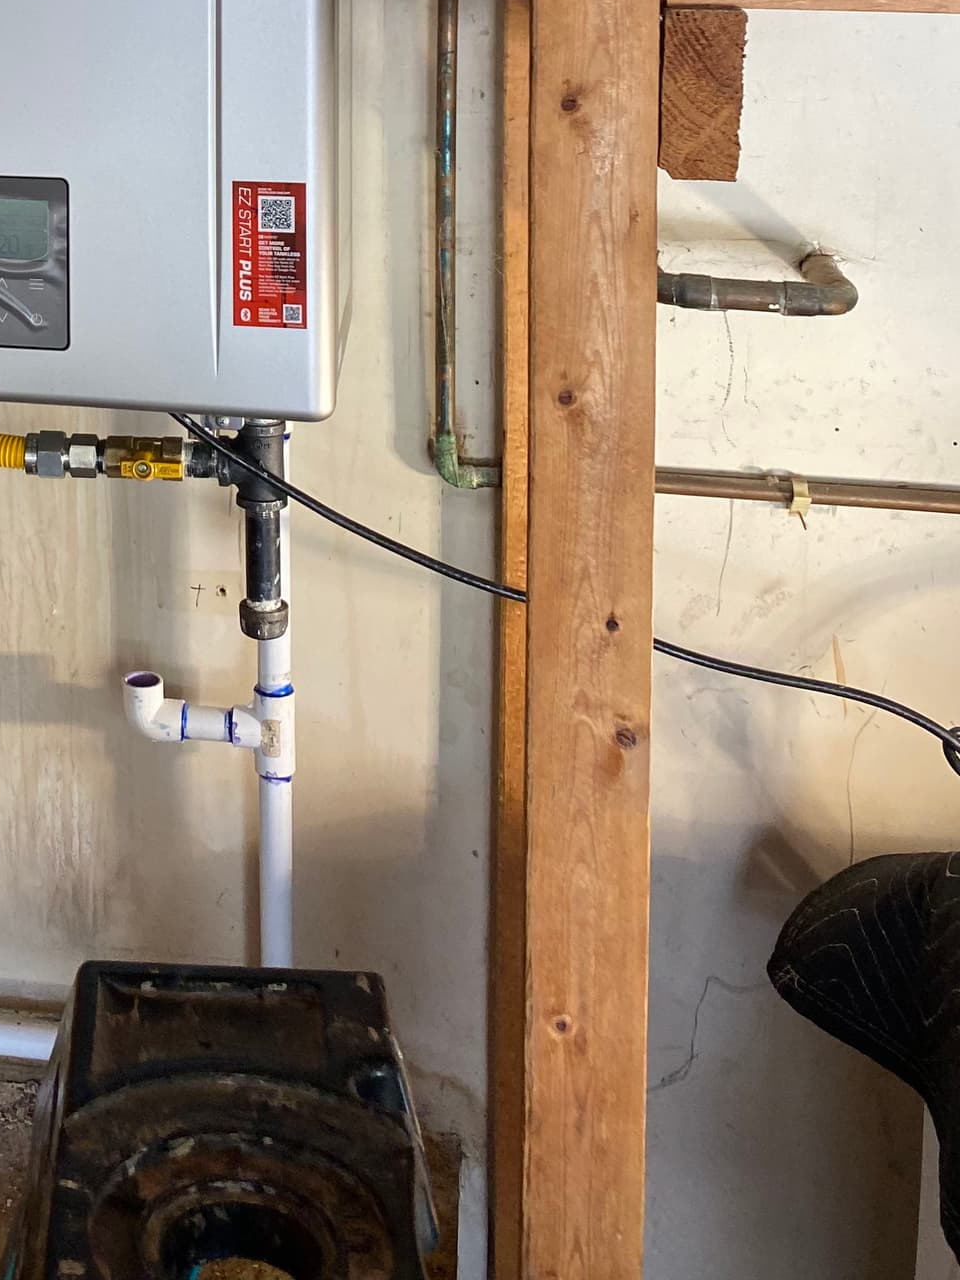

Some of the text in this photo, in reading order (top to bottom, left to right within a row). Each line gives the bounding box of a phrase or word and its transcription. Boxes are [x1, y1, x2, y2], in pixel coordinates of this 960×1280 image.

[238, 186, 253, 302] EZ START PLUS
